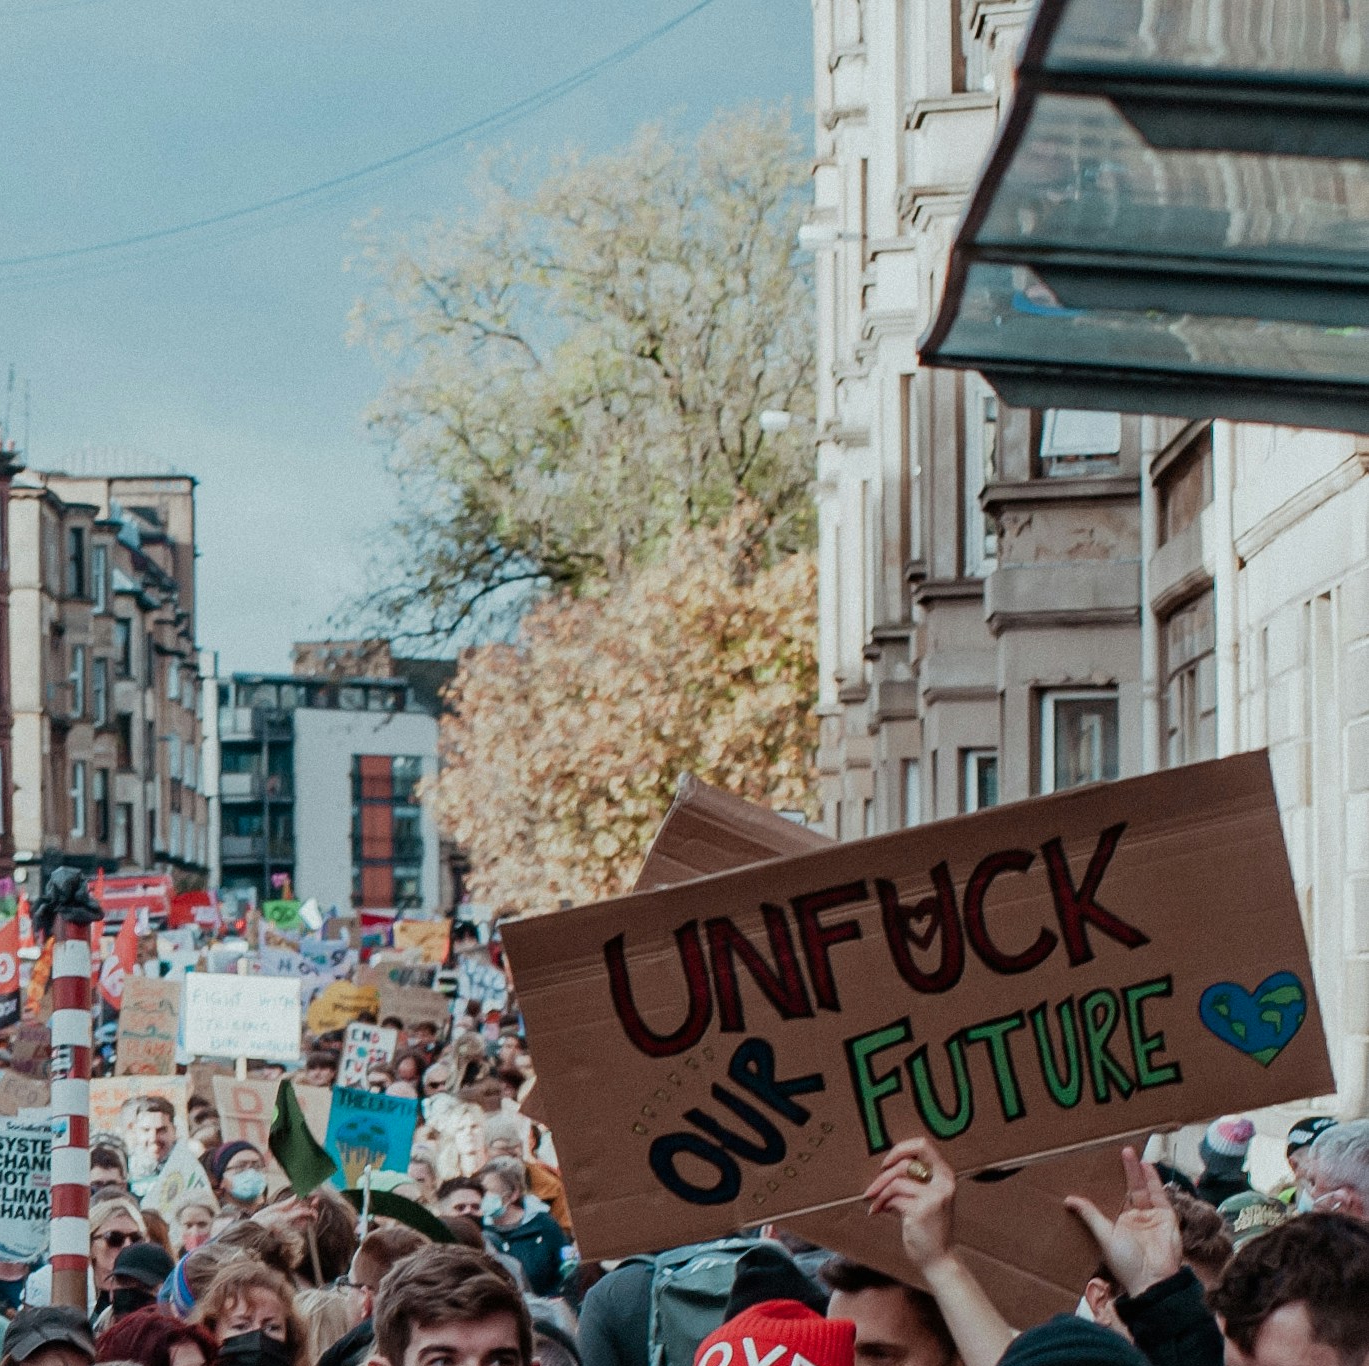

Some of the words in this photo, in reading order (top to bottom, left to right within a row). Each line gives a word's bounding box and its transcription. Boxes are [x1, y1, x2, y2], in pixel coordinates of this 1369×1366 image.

[603, 820, 1151, 1059] UNFUCK
[648, 1036, 826, 1205] OUR
[844, 974, 1184, 1156] FUTURE
